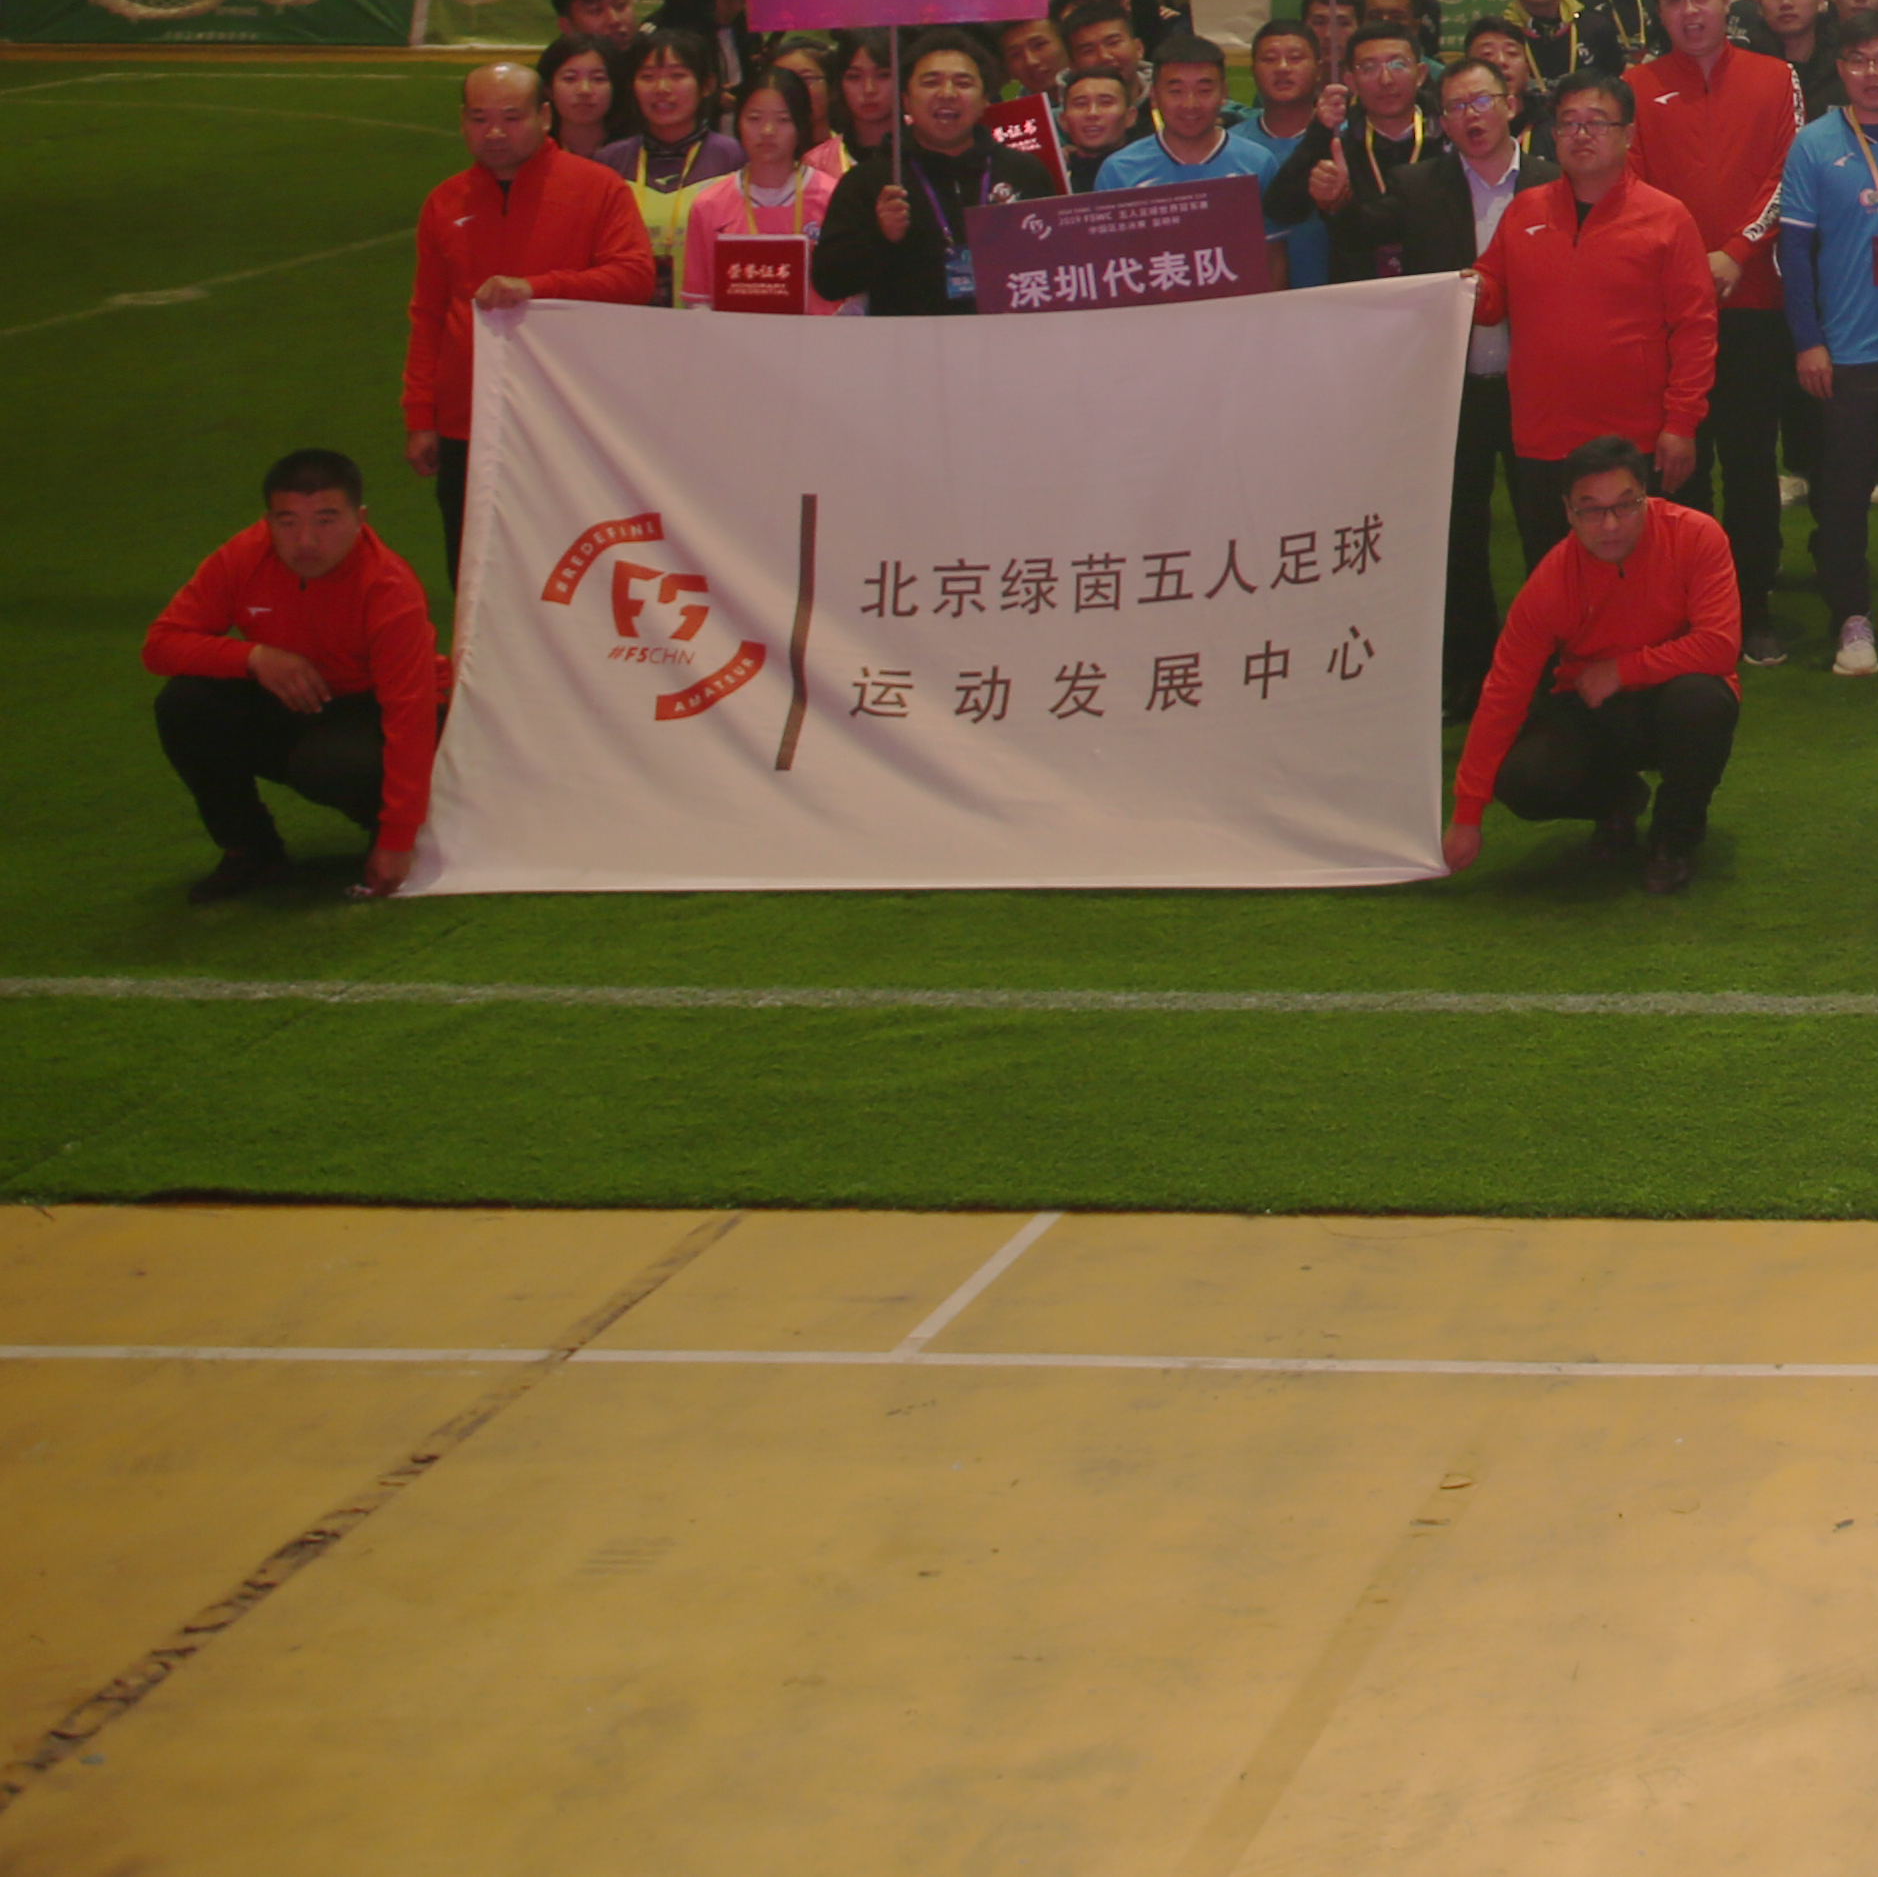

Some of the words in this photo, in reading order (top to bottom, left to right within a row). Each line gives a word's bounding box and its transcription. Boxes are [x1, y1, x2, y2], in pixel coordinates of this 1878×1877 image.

[1006, 246, 1239, 308] 深圳代表队
[859, 512, 1385, 622] 北京绿茵五人足球
[674, 656, 755, 712] AMATEUR
[849, 622, 1377, 723] 运动发展中心
